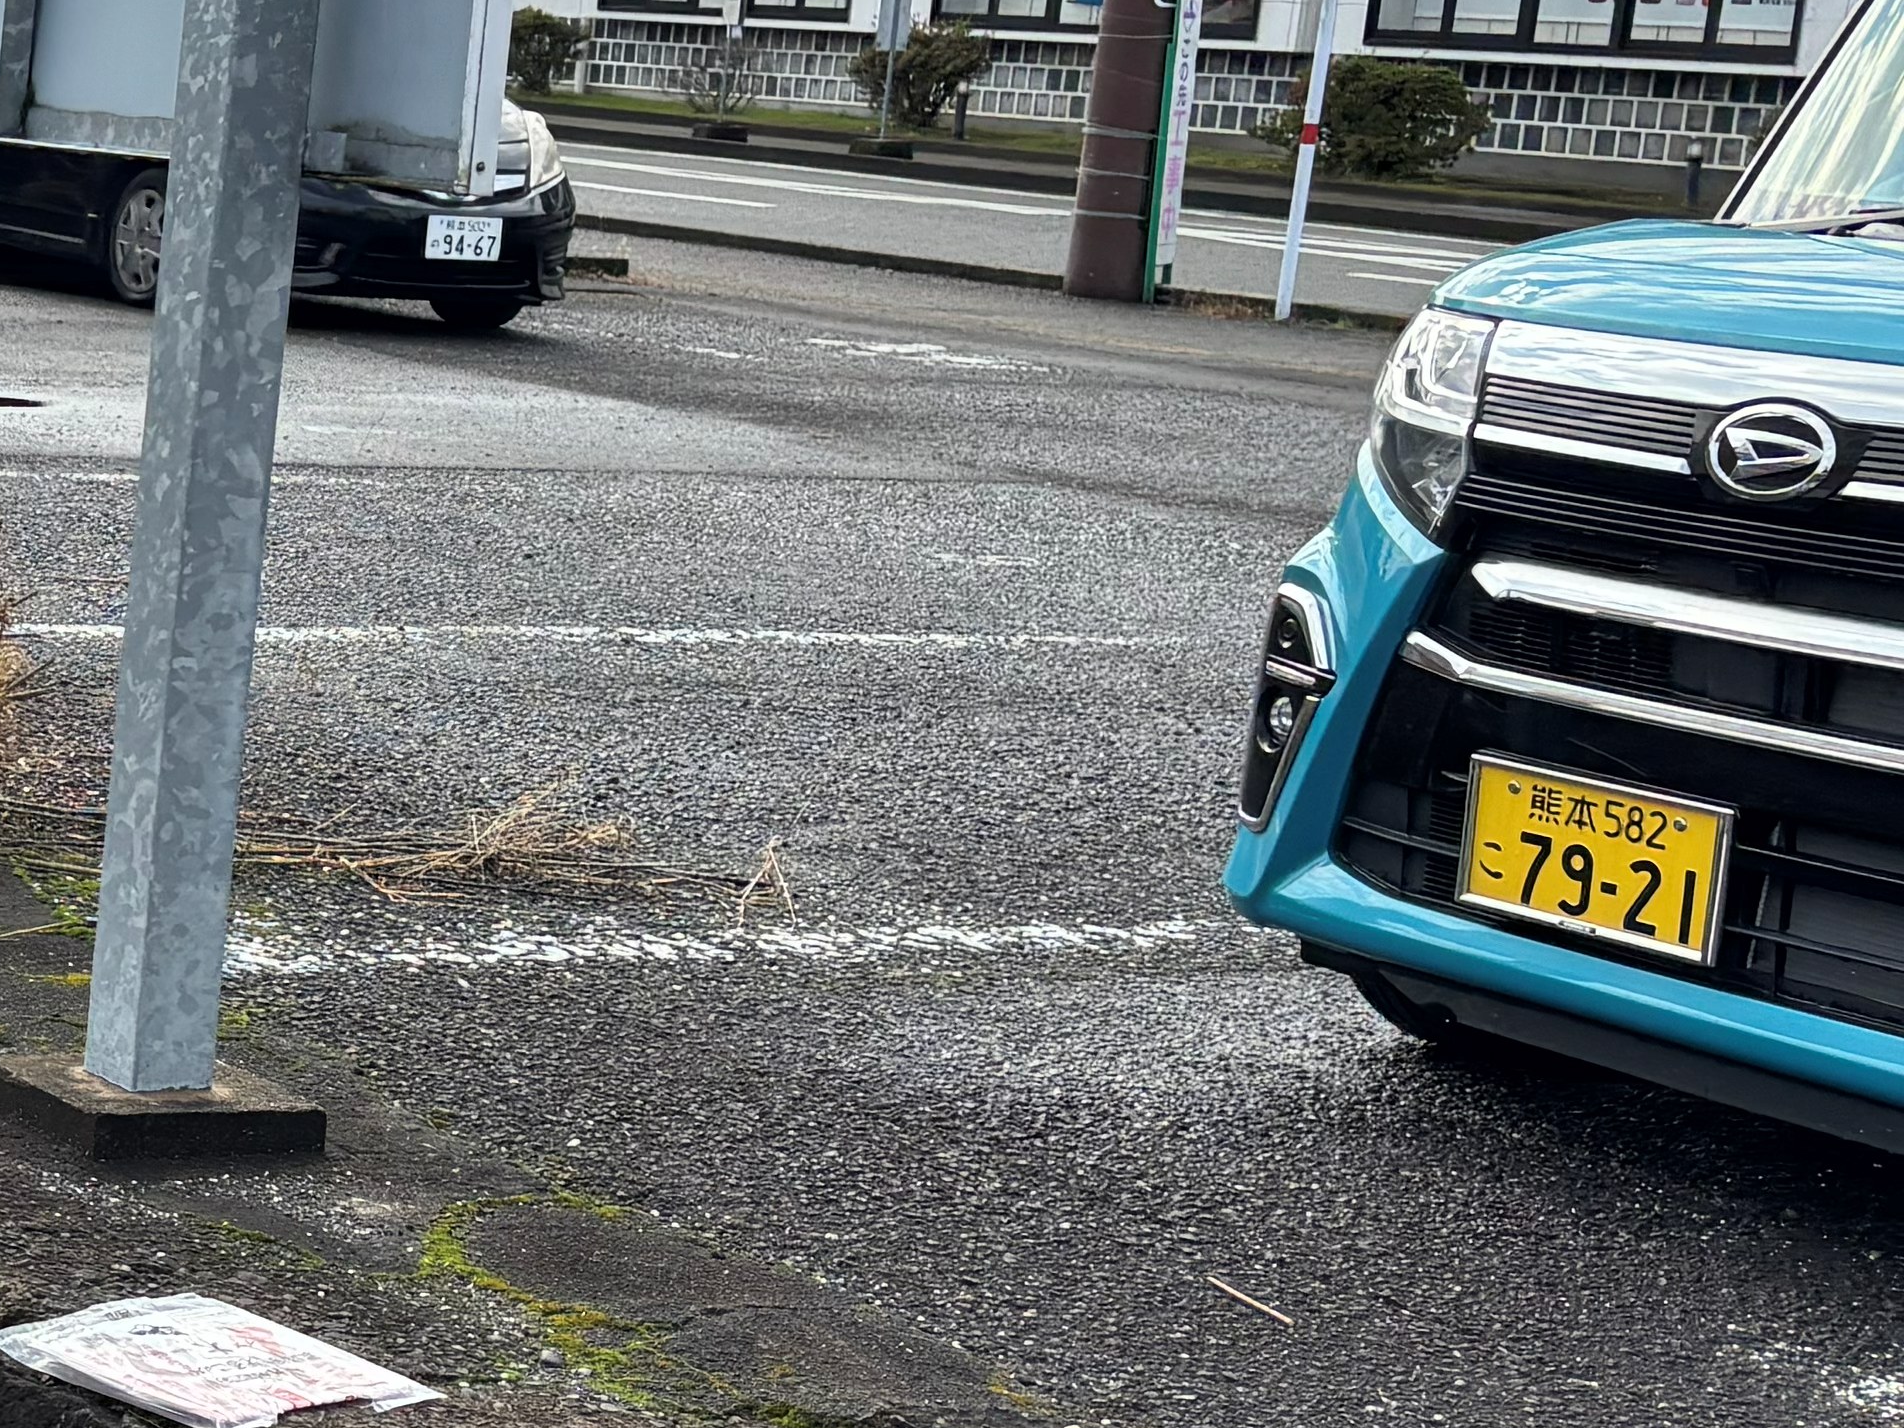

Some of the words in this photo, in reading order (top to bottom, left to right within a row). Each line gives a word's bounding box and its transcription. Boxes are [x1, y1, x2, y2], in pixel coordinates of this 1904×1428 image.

[444, 234, 497, 258] 94-67
[1479, 841, 1504, 879] こ
[1520, 831, 1697, 945] 79-21
